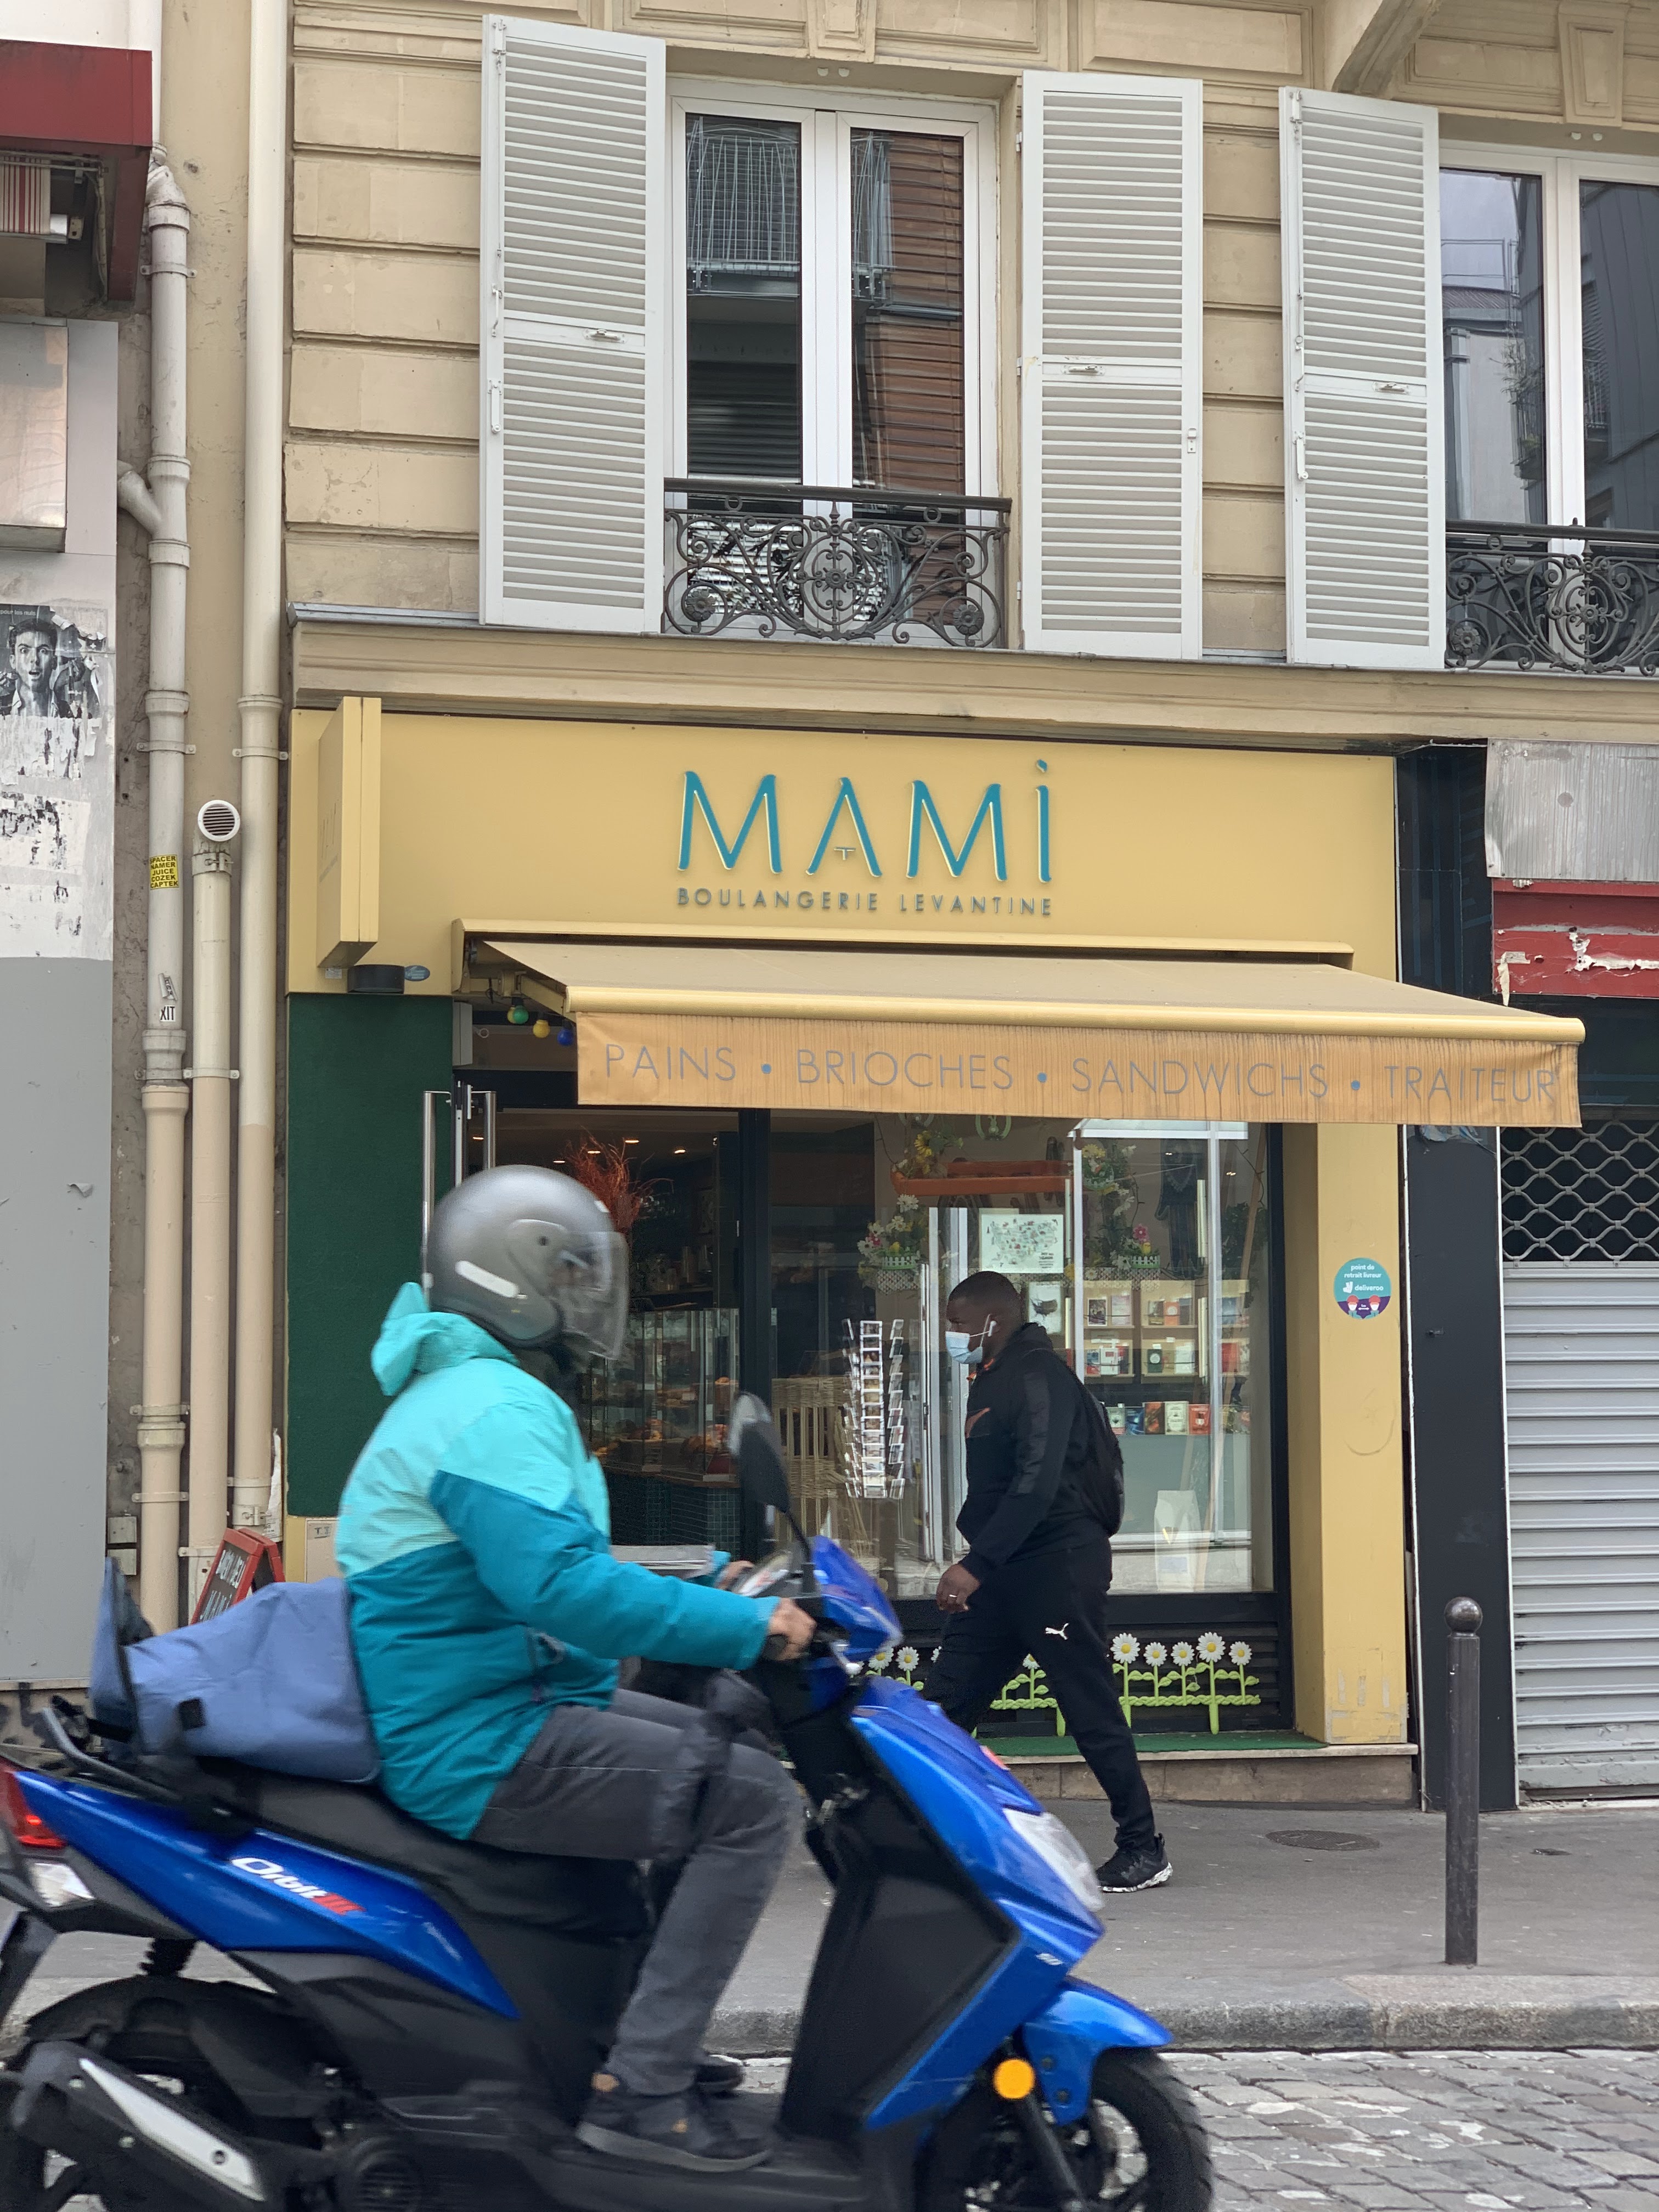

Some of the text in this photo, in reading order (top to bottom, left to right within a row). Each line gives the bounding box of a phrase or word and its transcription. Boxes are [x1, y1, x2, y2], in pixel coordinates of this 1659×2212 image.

[677, 887, 1052, 916] BOULANGERIE LEVANTINE
[605, 1043, 1555, 1103] PAINS BRIOCHES SANDWICHS TRAITEUR
